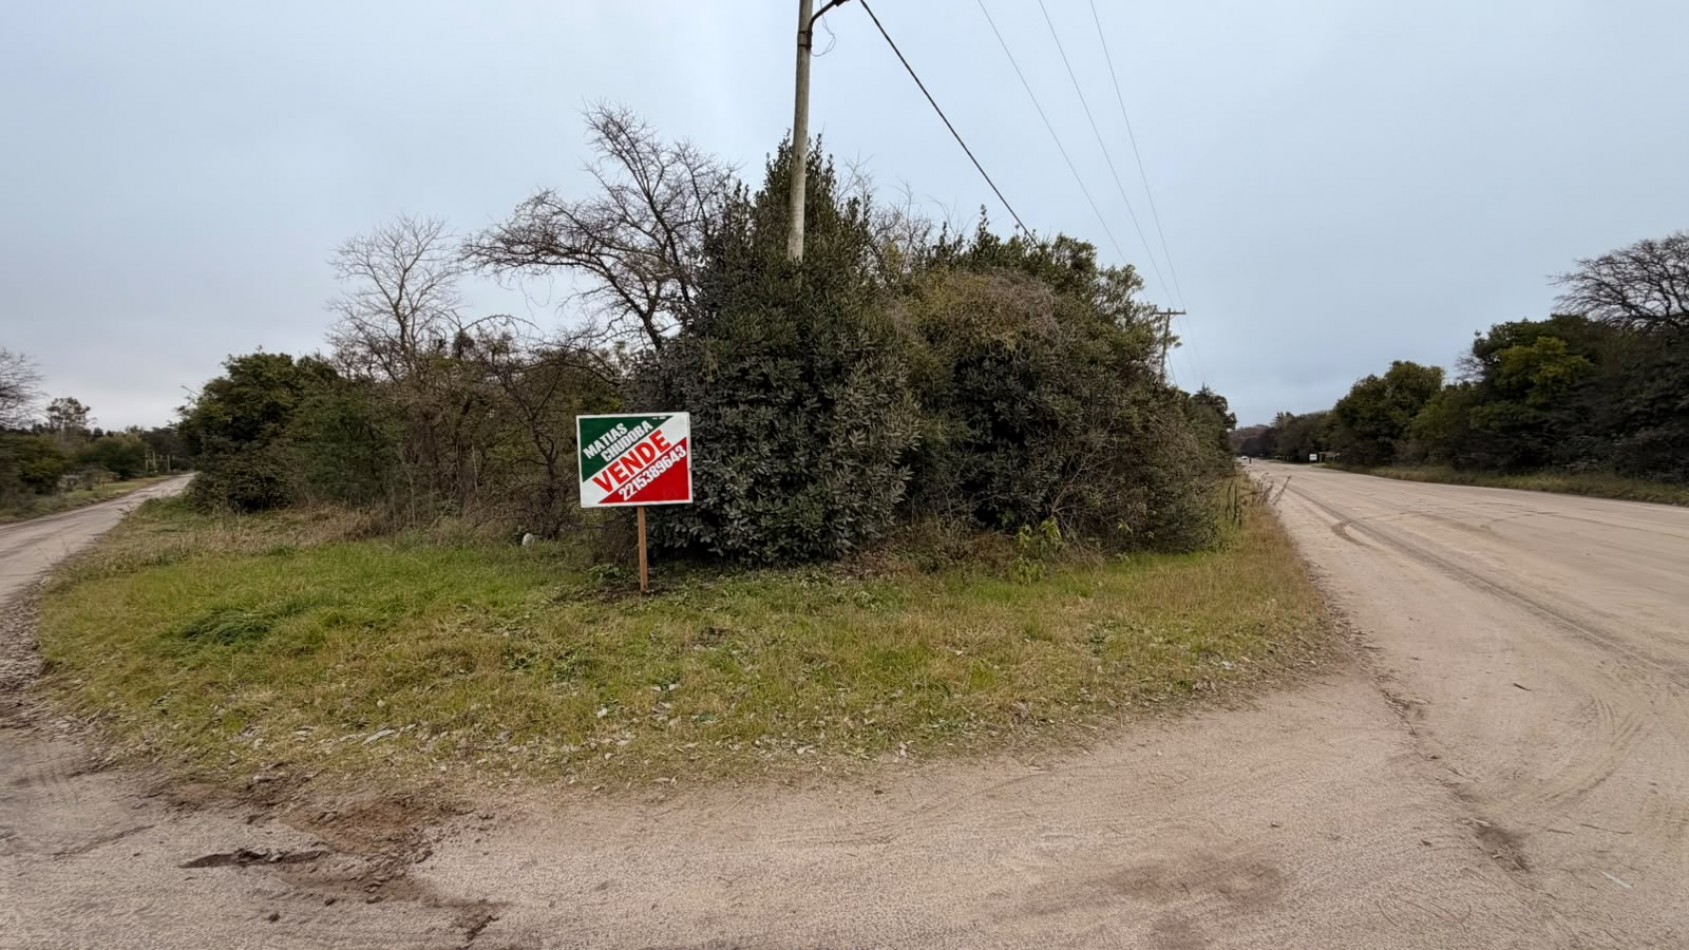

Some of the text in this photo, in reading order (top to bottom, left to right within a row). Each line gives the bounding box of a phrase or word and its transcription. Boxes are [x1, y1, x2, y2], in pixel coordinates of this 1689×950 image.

[583, 423, 628, 459] MATIAS
[592, 429, 671, 493] VENDE
[600, 420, 653, 462] CHUDOBA
[618, 445, 687, 500] 2215389643
